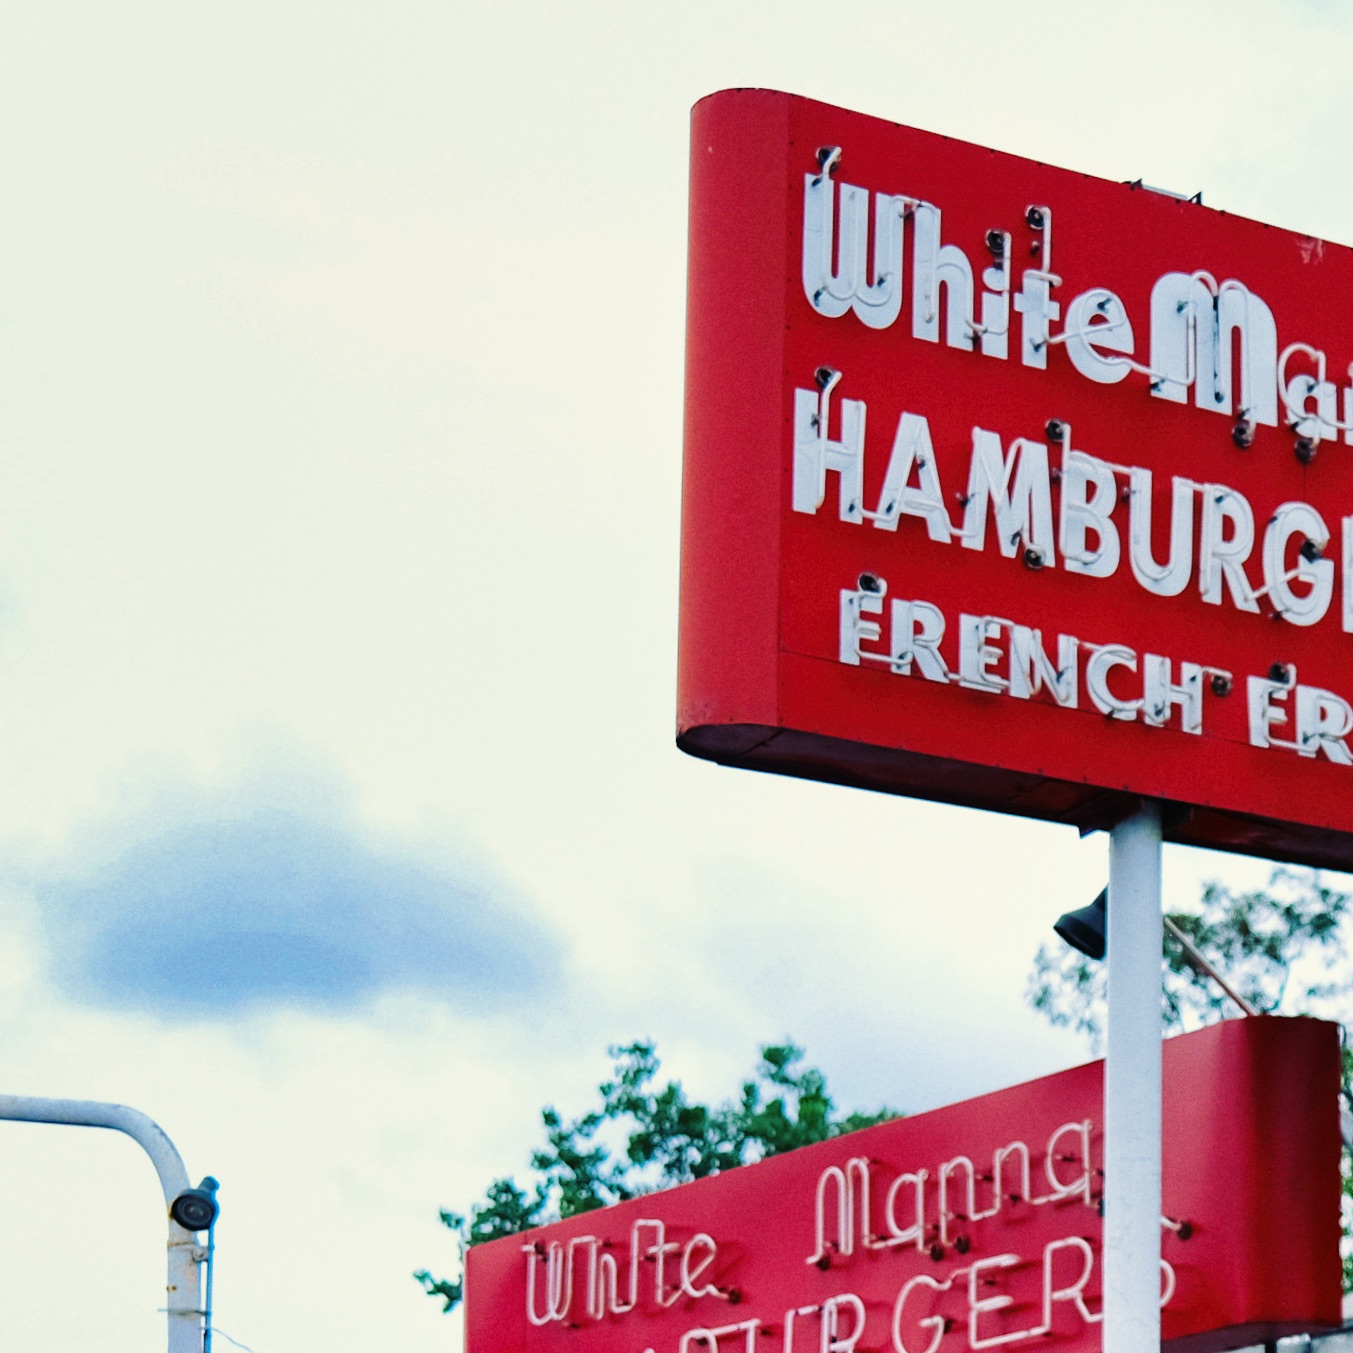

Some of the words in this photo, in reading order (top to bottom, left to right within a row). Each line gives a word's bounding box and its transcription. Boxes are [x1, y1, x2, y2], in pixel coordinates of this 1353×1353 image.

[803, 168, 1135, 385] White
[839, 586, 1204, 735] FRENCH
[524, 1217, 720, 1325] White
[808, 1119, 1092, 1264] Manna
